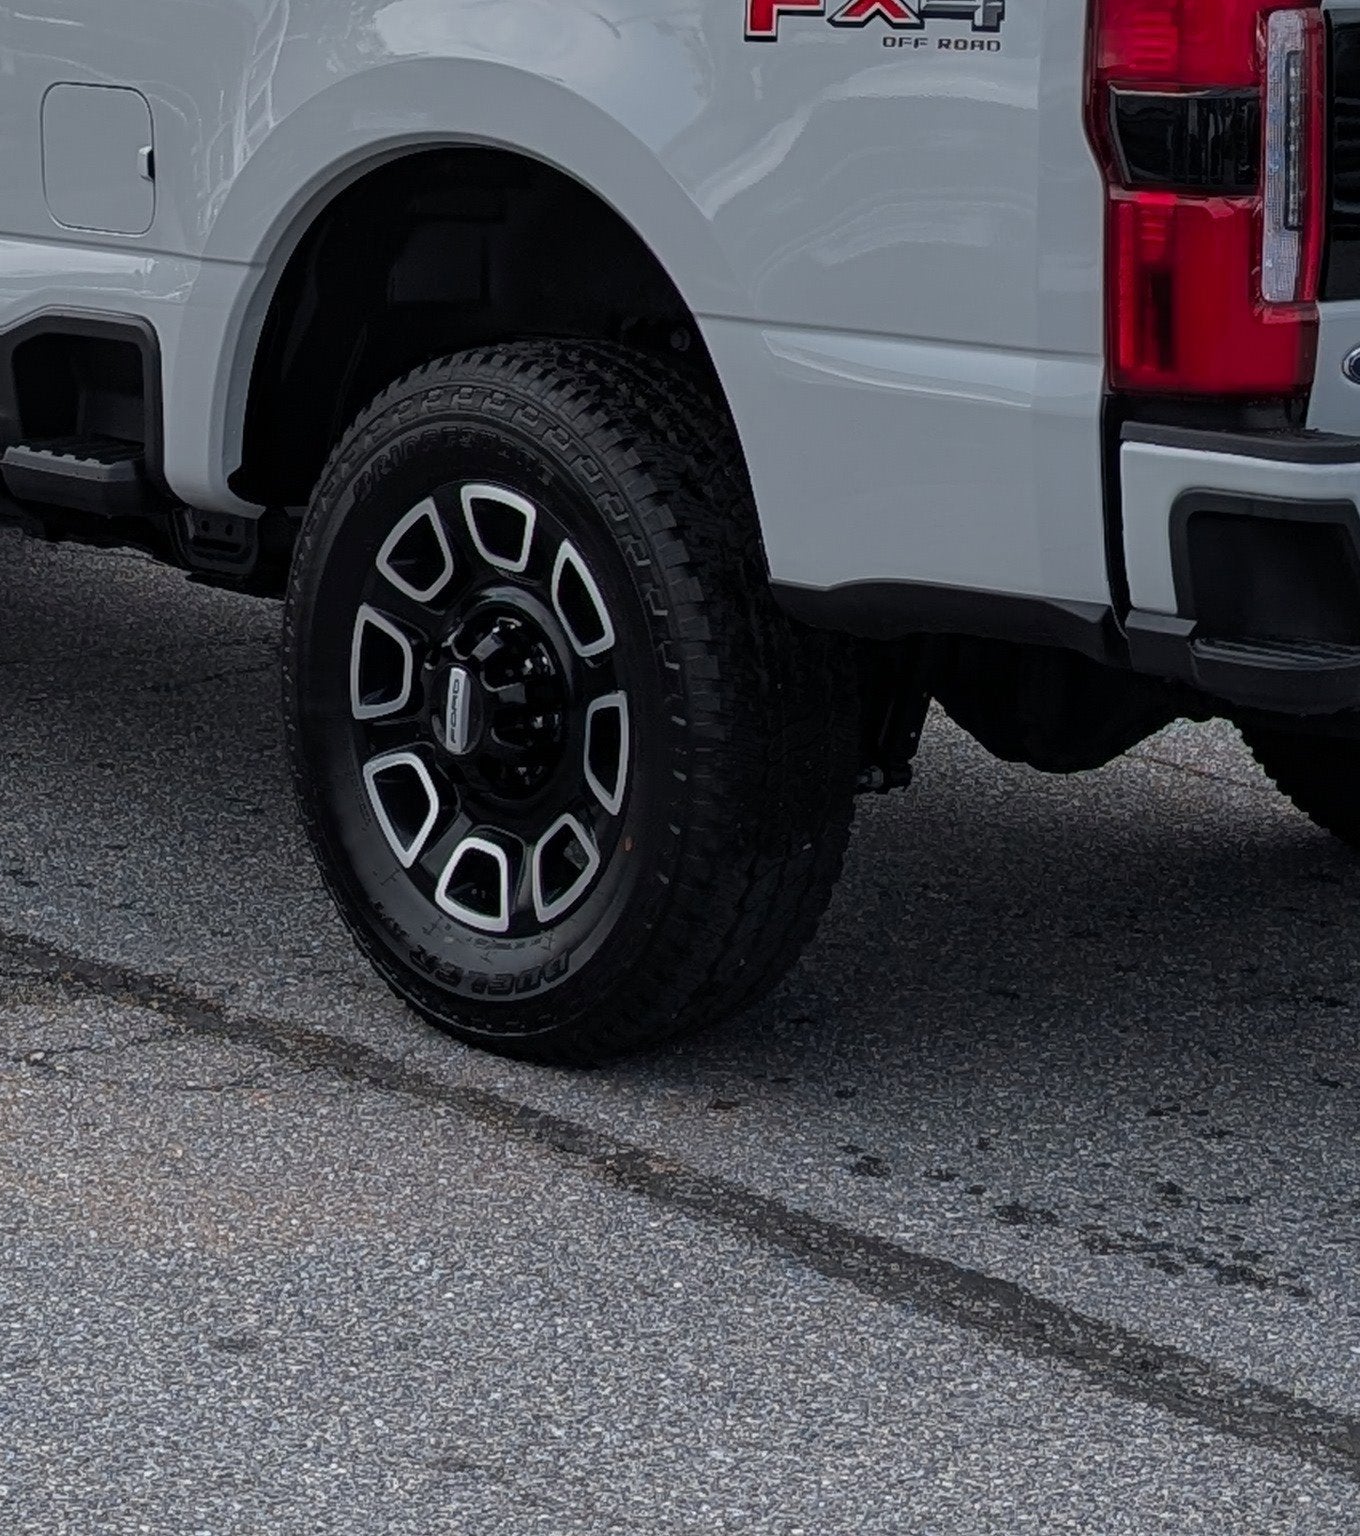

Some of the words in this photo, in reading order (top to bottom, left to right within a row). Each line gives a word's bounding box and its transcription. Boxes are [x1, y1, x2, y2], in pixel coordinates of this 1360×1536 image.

[883, 36, 928, 49] OFF
[937, 37, 1001, 52] ROAD
[450, 678, 460, 745] FORD
